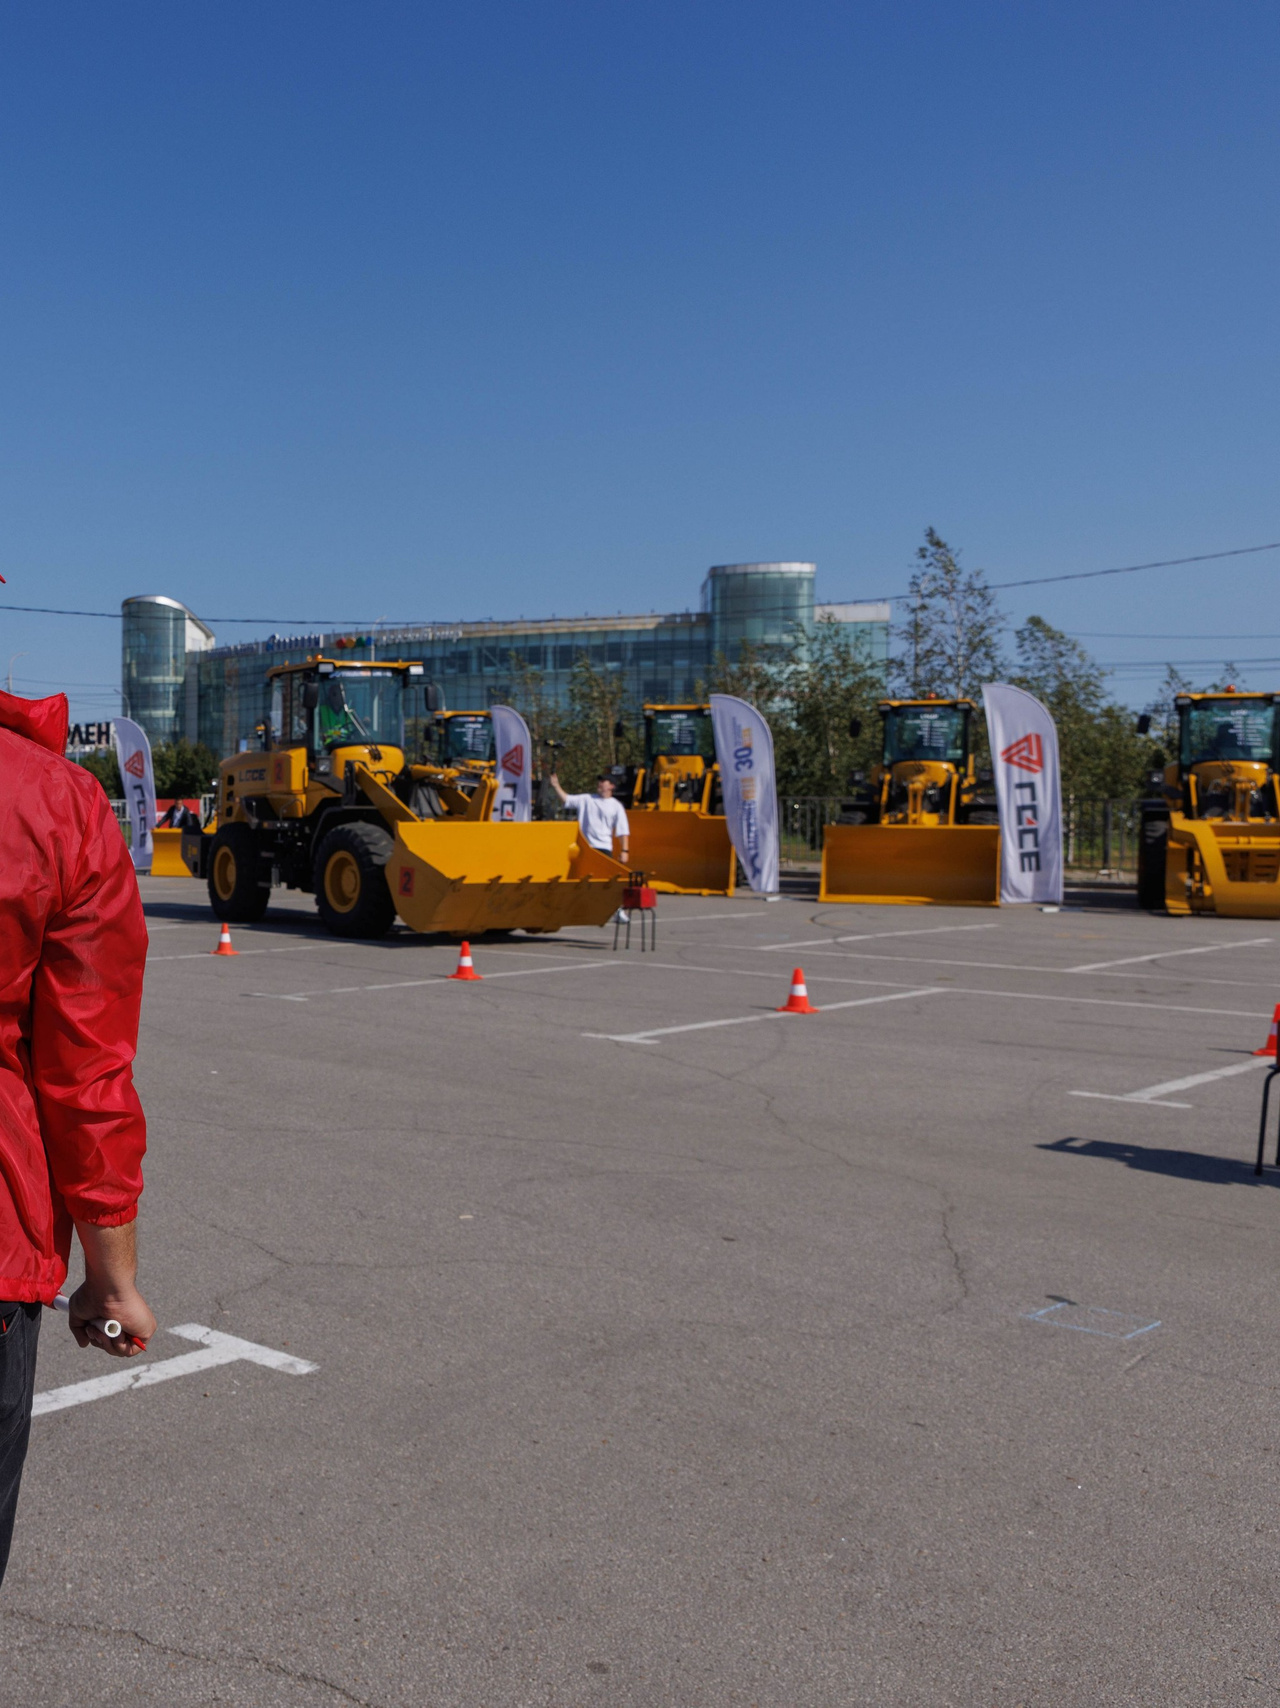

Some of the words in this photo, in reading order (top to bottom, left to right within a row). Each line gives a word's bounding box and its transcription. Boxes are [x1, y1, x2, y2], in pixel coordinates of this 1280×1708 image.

[68, 722, 110, 745] ЛЕН
[733, 747, 754, 773] 30
[500, 783, 518, 821] LG
[1015, 782, 1041, 873] LGCE
[402, 871, 412, 893] 2
